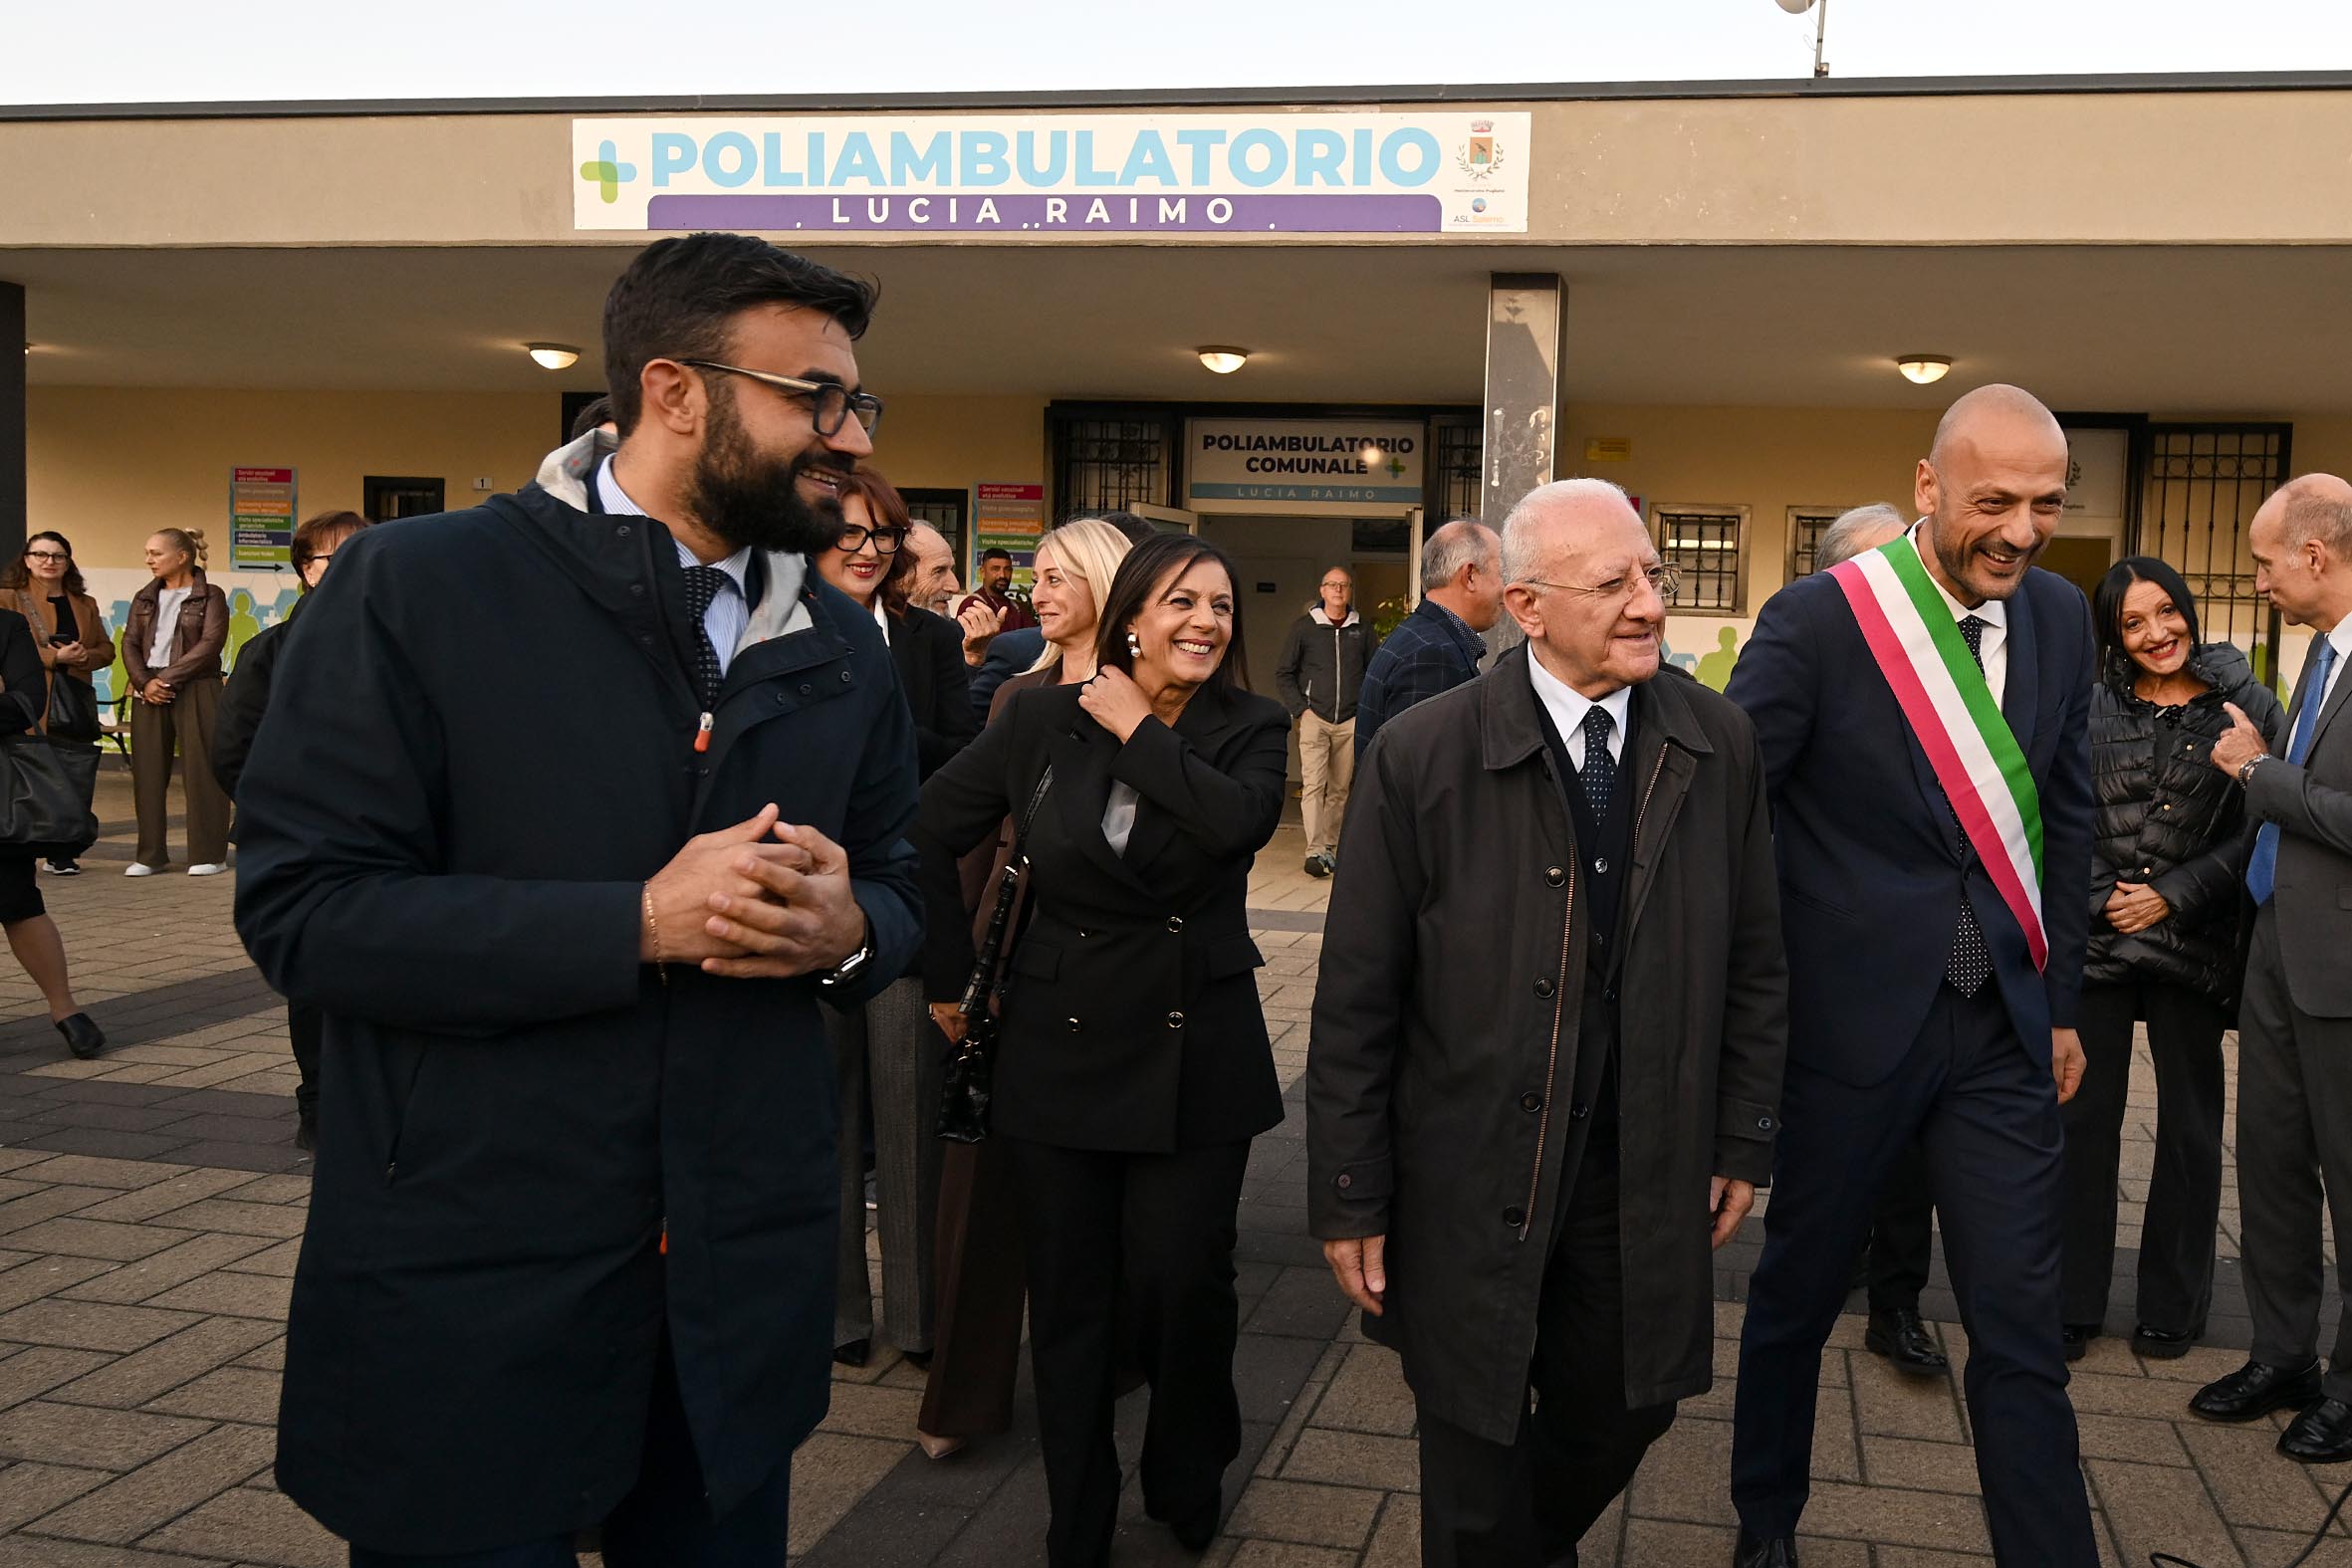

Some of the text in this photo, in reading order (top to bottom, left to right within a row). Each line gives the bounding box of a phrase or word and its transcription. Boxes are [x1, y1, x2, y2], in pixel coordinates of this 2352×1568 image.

[653, 126, 1441, 188] POLIAMBULATORIO
[831, 197, 1234, 224] LUCIA RAIMO
[1202, 434, 1415, 454] POLIAMBULATORIO
[1245, 456, 1369, 475] COMUNALE
[480, 478, 485, 489] 1
[1238, 487, 1375, 500] LUCIA RAIMO
